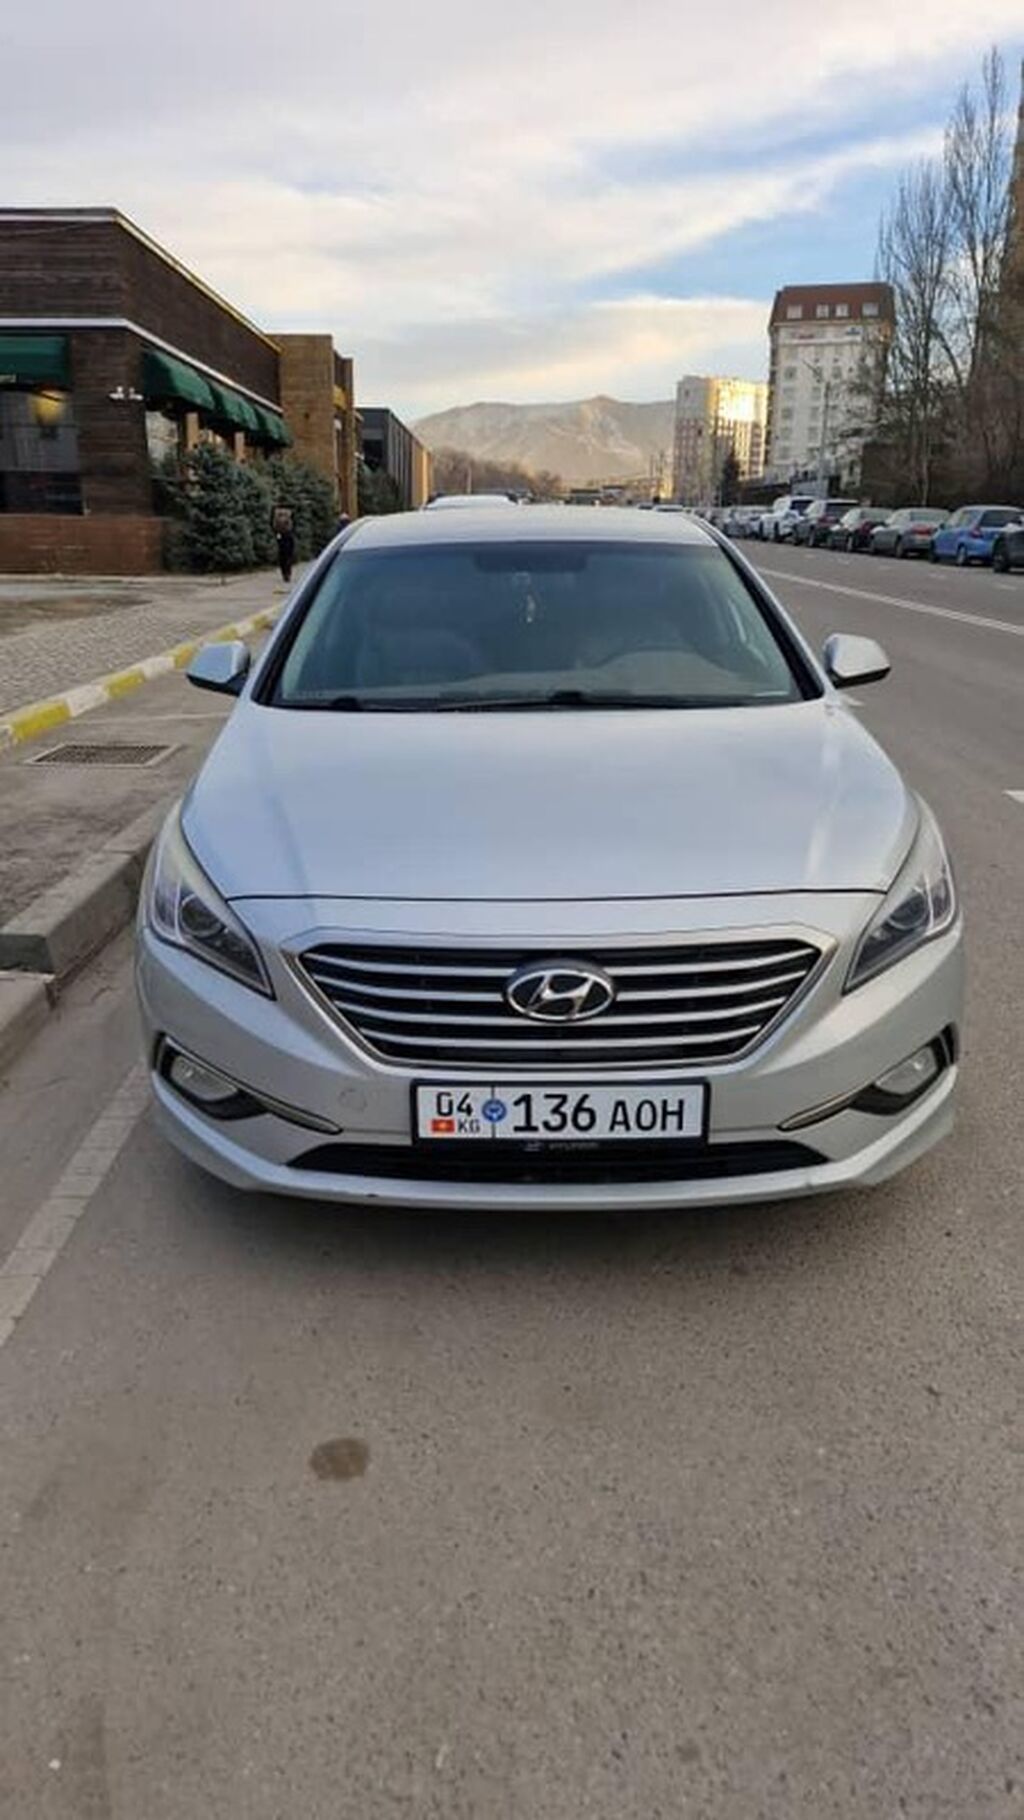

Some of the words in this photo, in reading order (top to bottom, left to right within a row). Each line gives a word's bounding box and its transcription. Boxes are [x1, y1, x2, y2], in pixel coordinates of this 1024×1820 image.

[436, 1091, 473, 1116] 04
[513, 1094, 596, 1132] 136
[609, 1099, 684, 1131] AOH
[457, 1118, 480, 1133] KG
